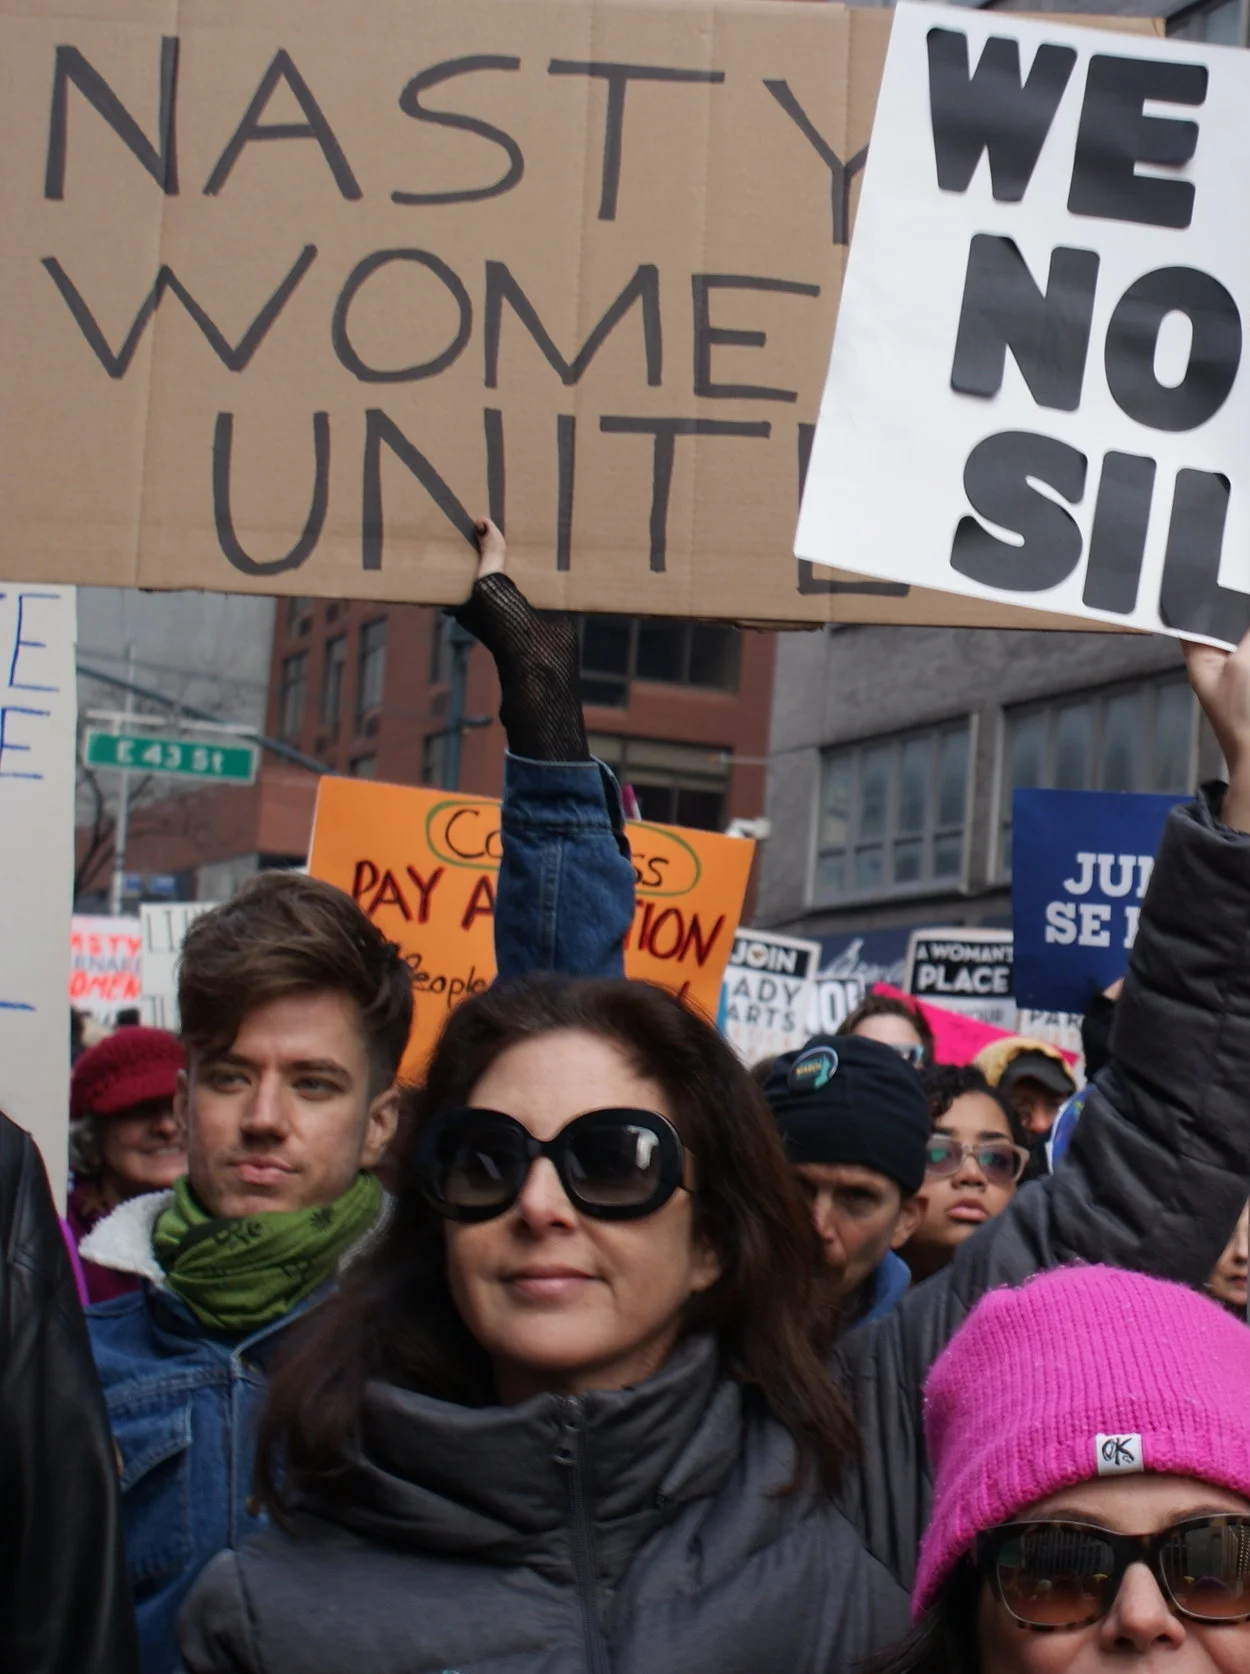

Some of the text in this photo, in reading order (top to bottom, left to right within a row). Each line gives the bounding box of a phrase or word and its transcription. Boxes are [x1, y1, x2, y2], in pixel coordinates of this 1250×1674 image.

[44, 36, 870, 246] NASTY
[926, 27, 1209, 230] WE
[41, 245, 822, 403] WOME
[116, 740, 224, 774] E 43 St
[352, 860, 444, 924] PAY
[1063, 852, 1155, 898] JU
[1045, 900, 1111, 948] SE
[731, 940, 798, 974] JOIN
[917, 964, 1011, 993] PLACE
[733, 975, 802, 1005] ADY
[727, 1003, 798, 1033] ARTS
